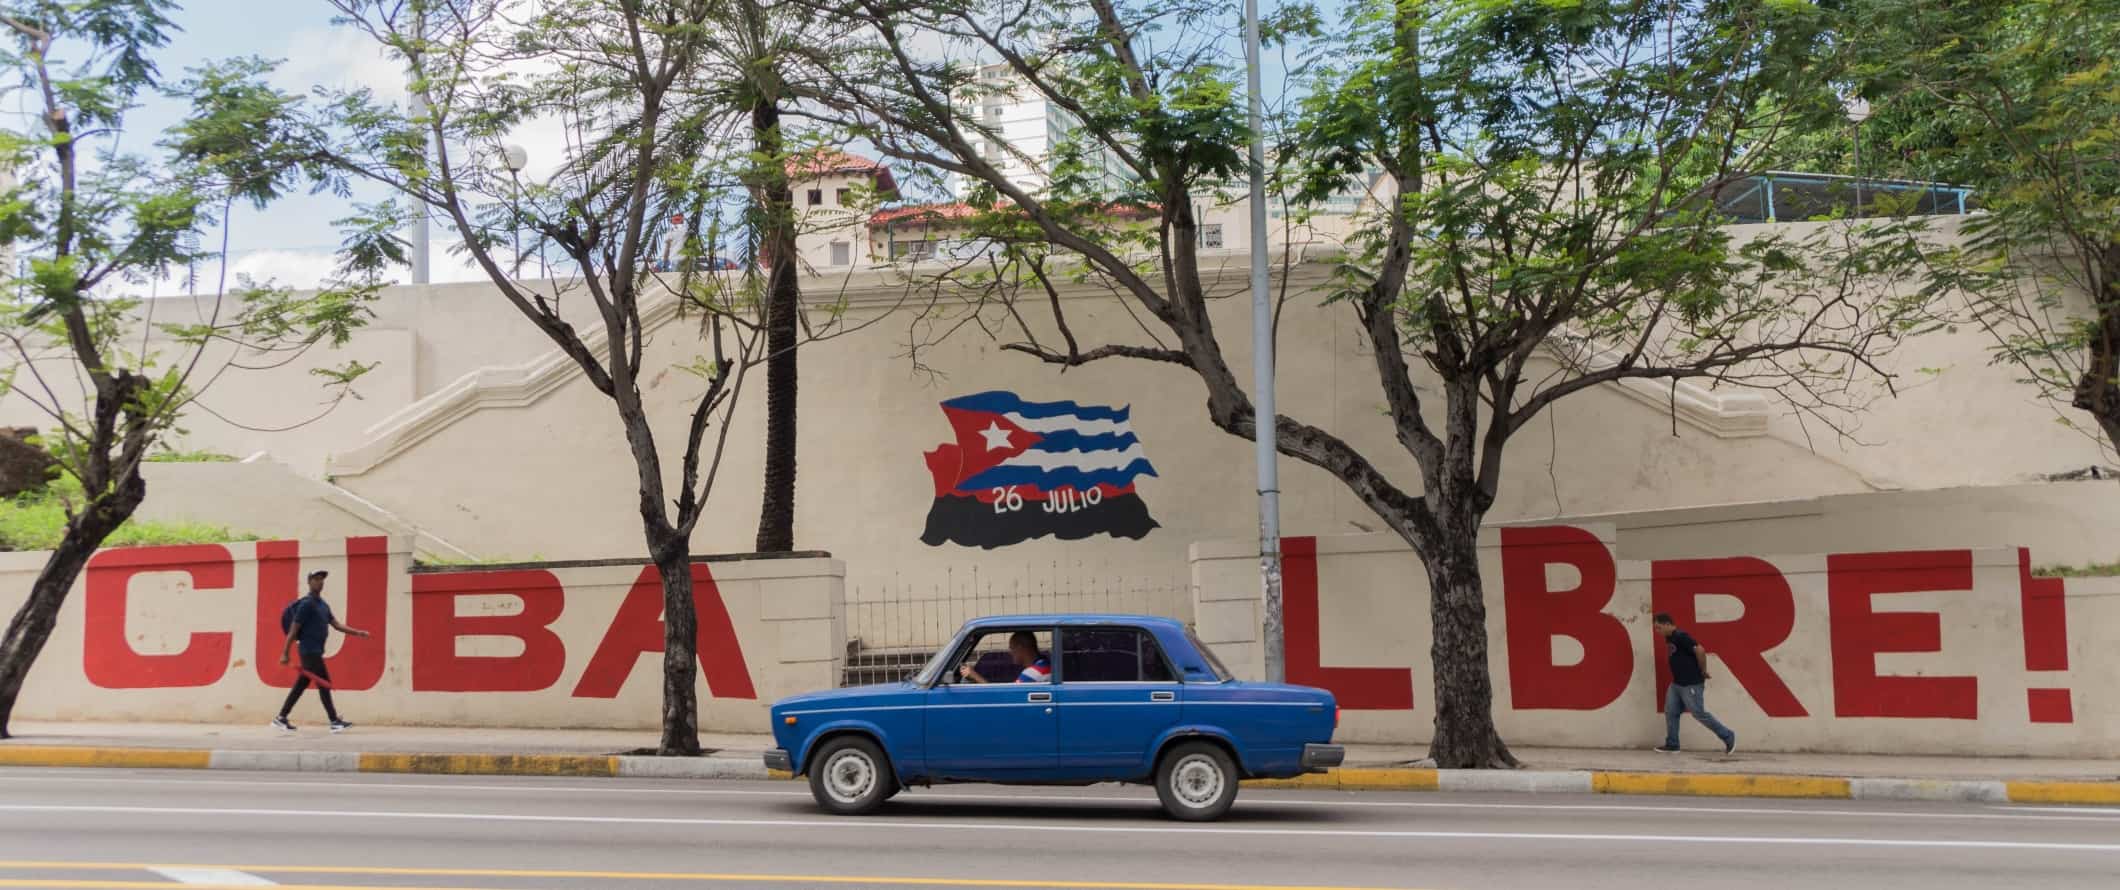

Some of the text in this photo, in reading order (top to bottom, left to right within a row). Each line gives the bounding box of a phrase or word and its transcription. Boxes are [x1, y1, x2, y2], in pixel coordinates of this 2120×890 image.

[992, 485, 1102, 514] 26 JULIO
[84, 526, 2073, 723] CUBA LBRE!
